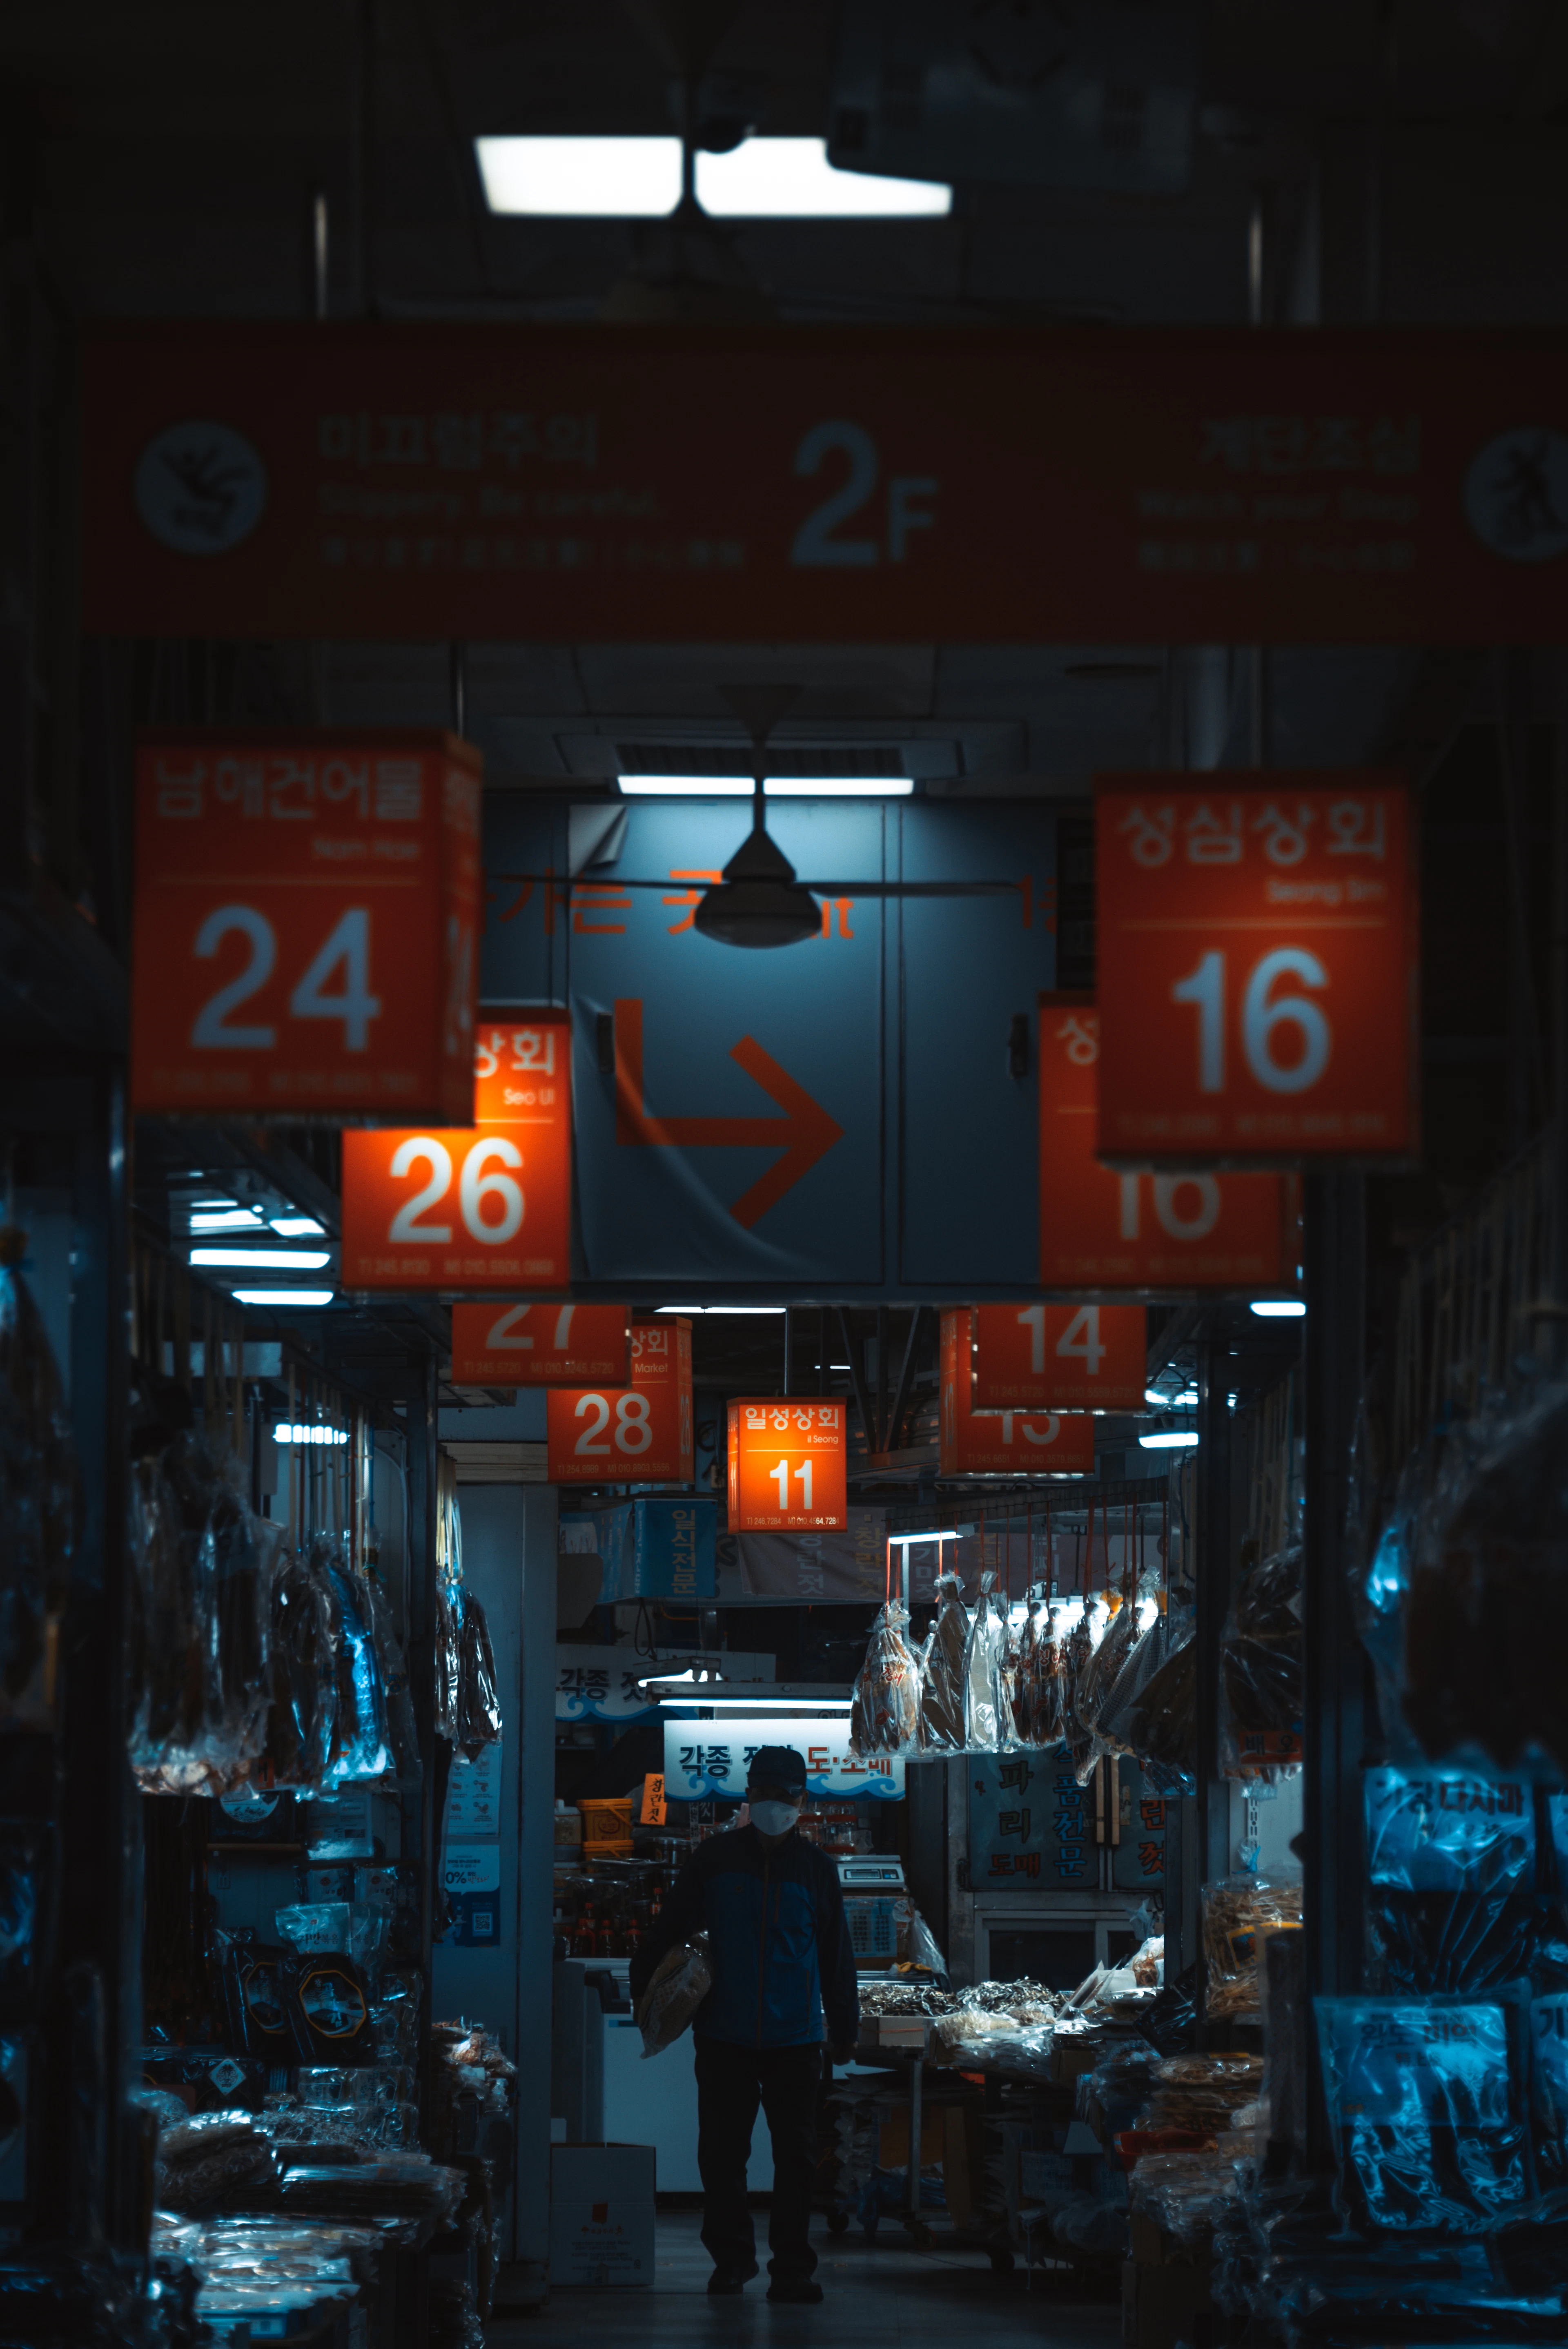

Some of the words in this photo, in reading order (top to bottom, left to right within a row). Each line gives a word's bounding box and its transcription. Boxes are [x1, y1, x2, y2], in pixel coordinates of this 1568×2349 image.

[318, 410, 599, 470] 미끄럼주의
[1197, 412, 1422, 474] 계단조심
[790, 420, 939, 568] 2F
[1116, 798, 1386, 867] 성심상회
[190, 903, 382, 1053] 24
[1170, 945, 1332, 1095] 16
[388, 1135, 524, 1246] 26
[635, 1363, 668, 1373] Market
[1017, 1304, 1107, 1375] 14
[574, 1393, 653, 1456] 28
[745, 1407, 839, 1431] 일성상회
[813, 1435, 839, 1444] Seong
[769, 1459, 813, 1510] 11
[671, 1508, 697, 1594] 일식전문
[854, 1527, 884, 1598] 창란젓
[560, 1668, 610, 1700] 각종
[679, 1745, 731, 1778] 각종
[988, 1852, 1041, 1879] 도매
